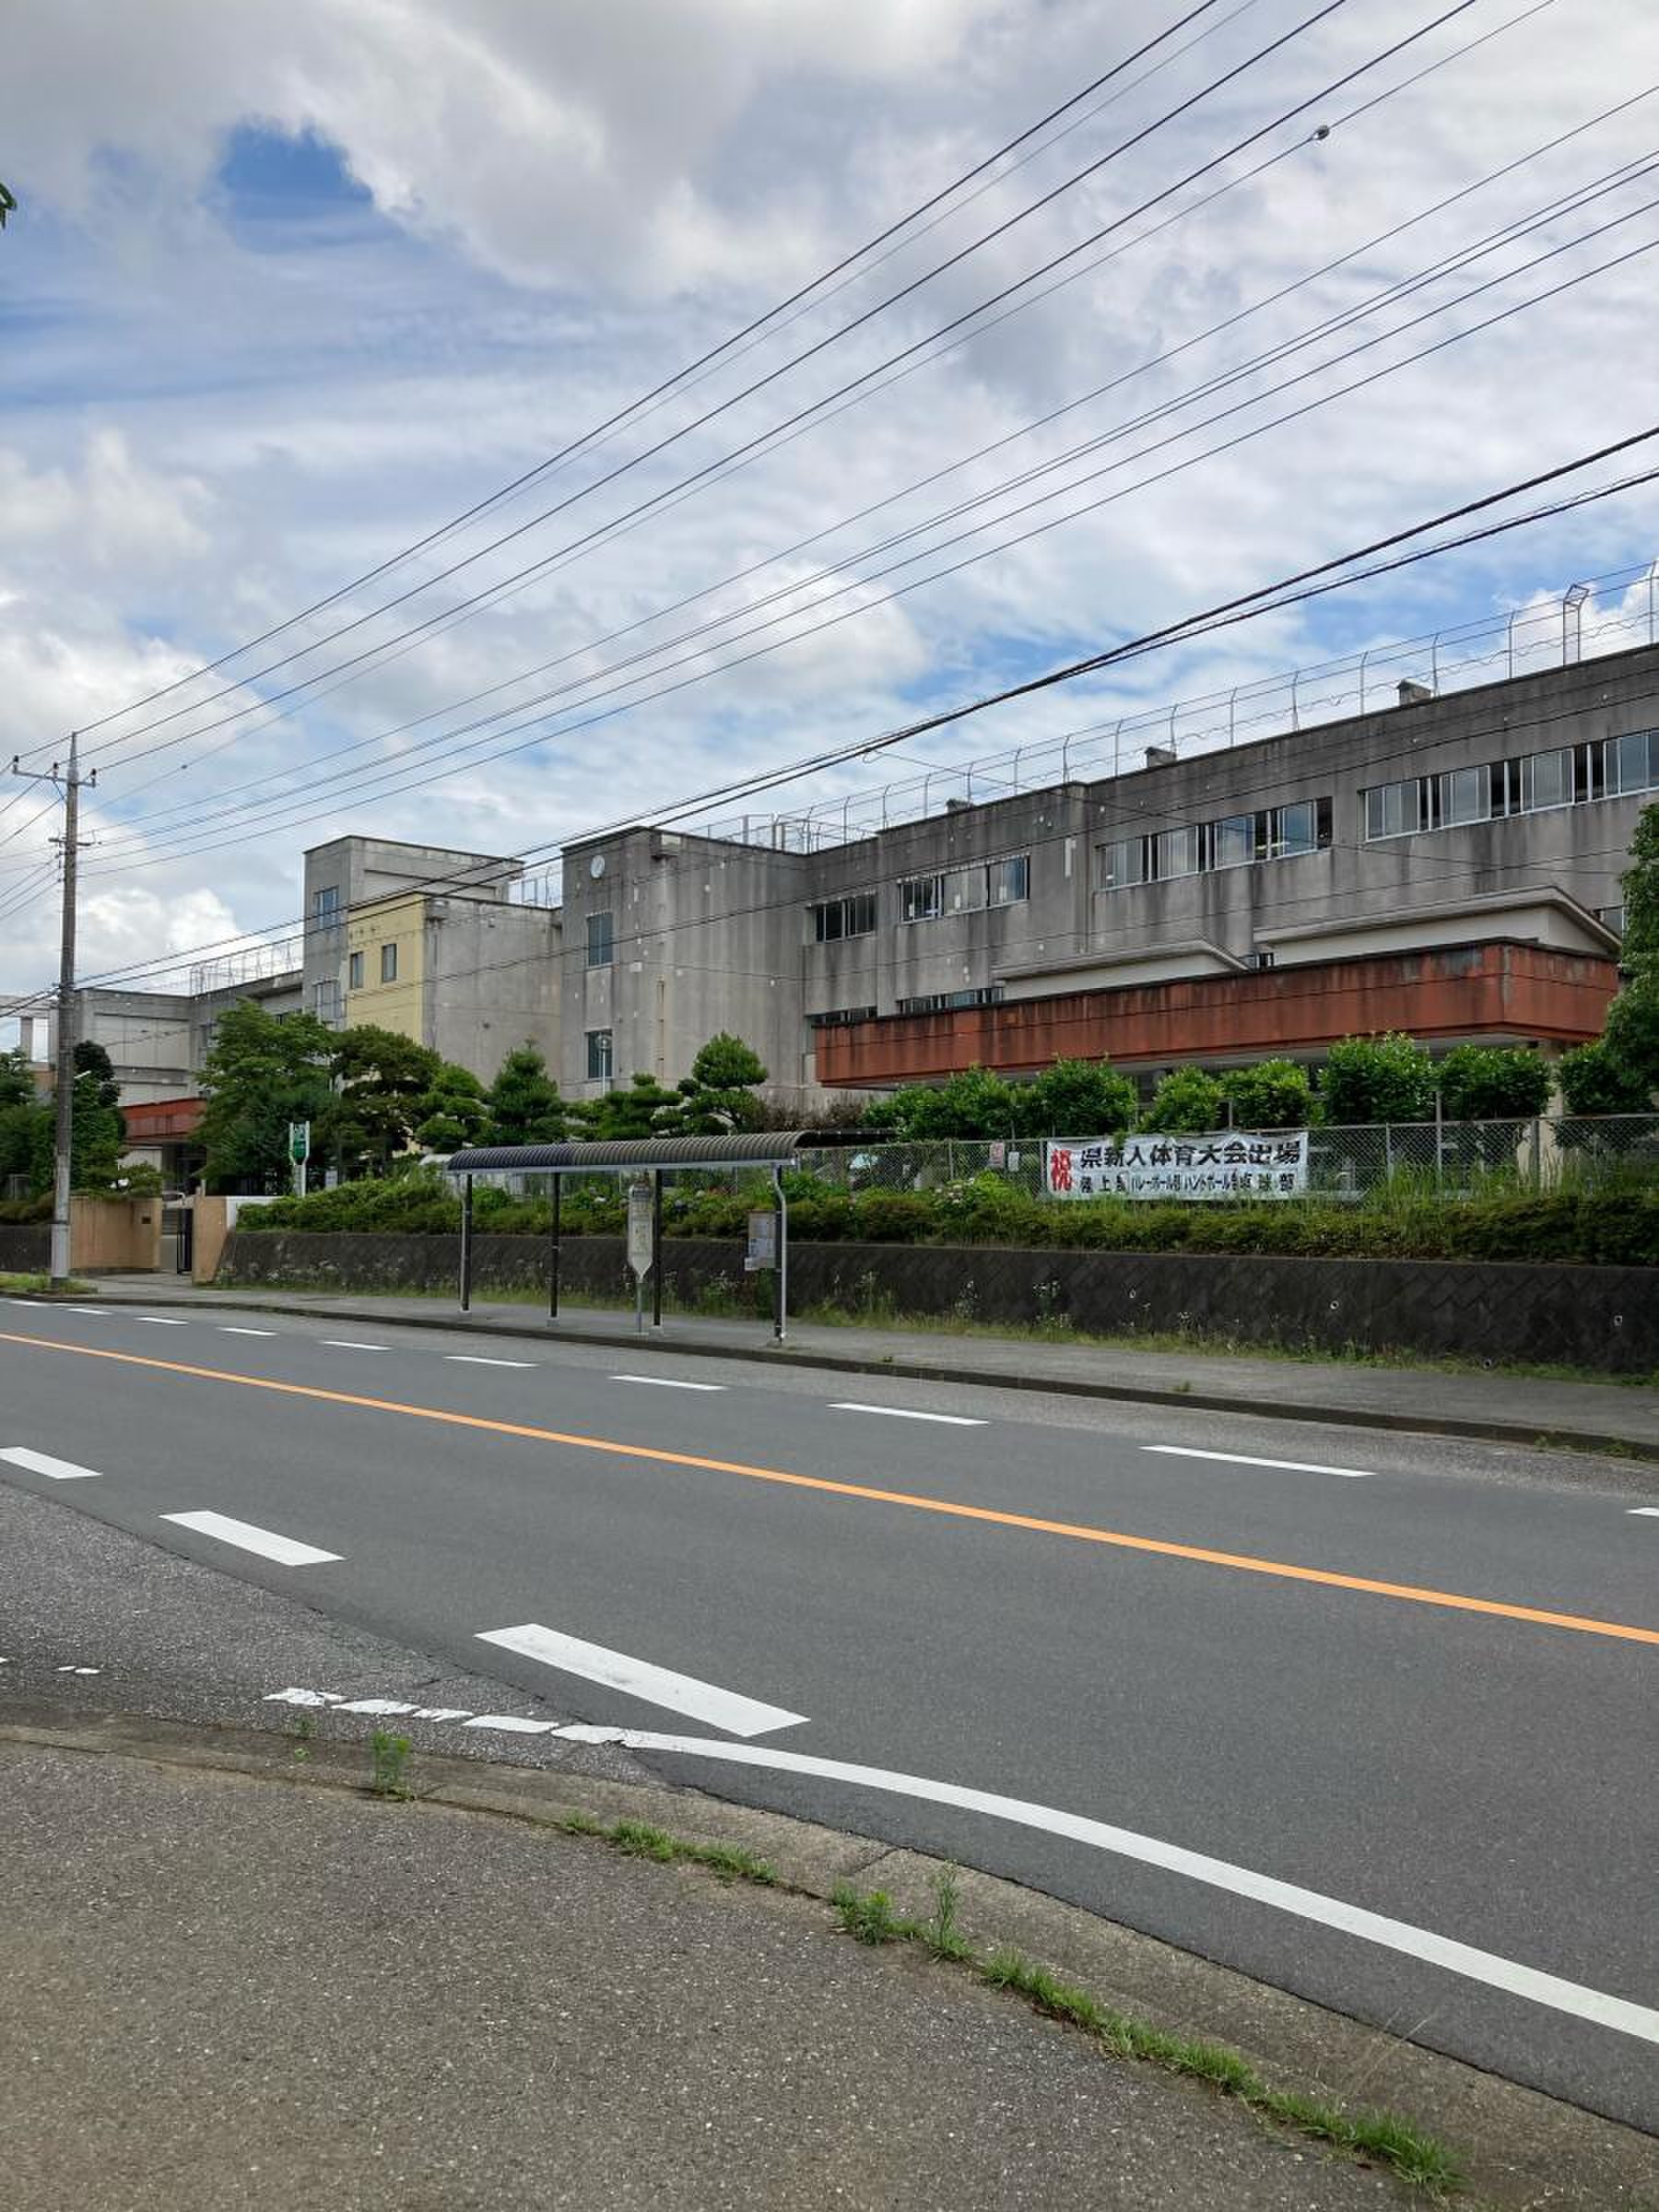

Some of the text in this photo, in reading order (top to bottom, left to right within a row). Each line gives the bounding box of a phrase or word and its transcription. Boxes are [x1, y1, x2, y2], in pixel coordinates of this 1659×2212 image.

[1050, 1148, 1074, 1192] 祝
[1080, 1140, 1301, 1169] 県新人体育大会出場
